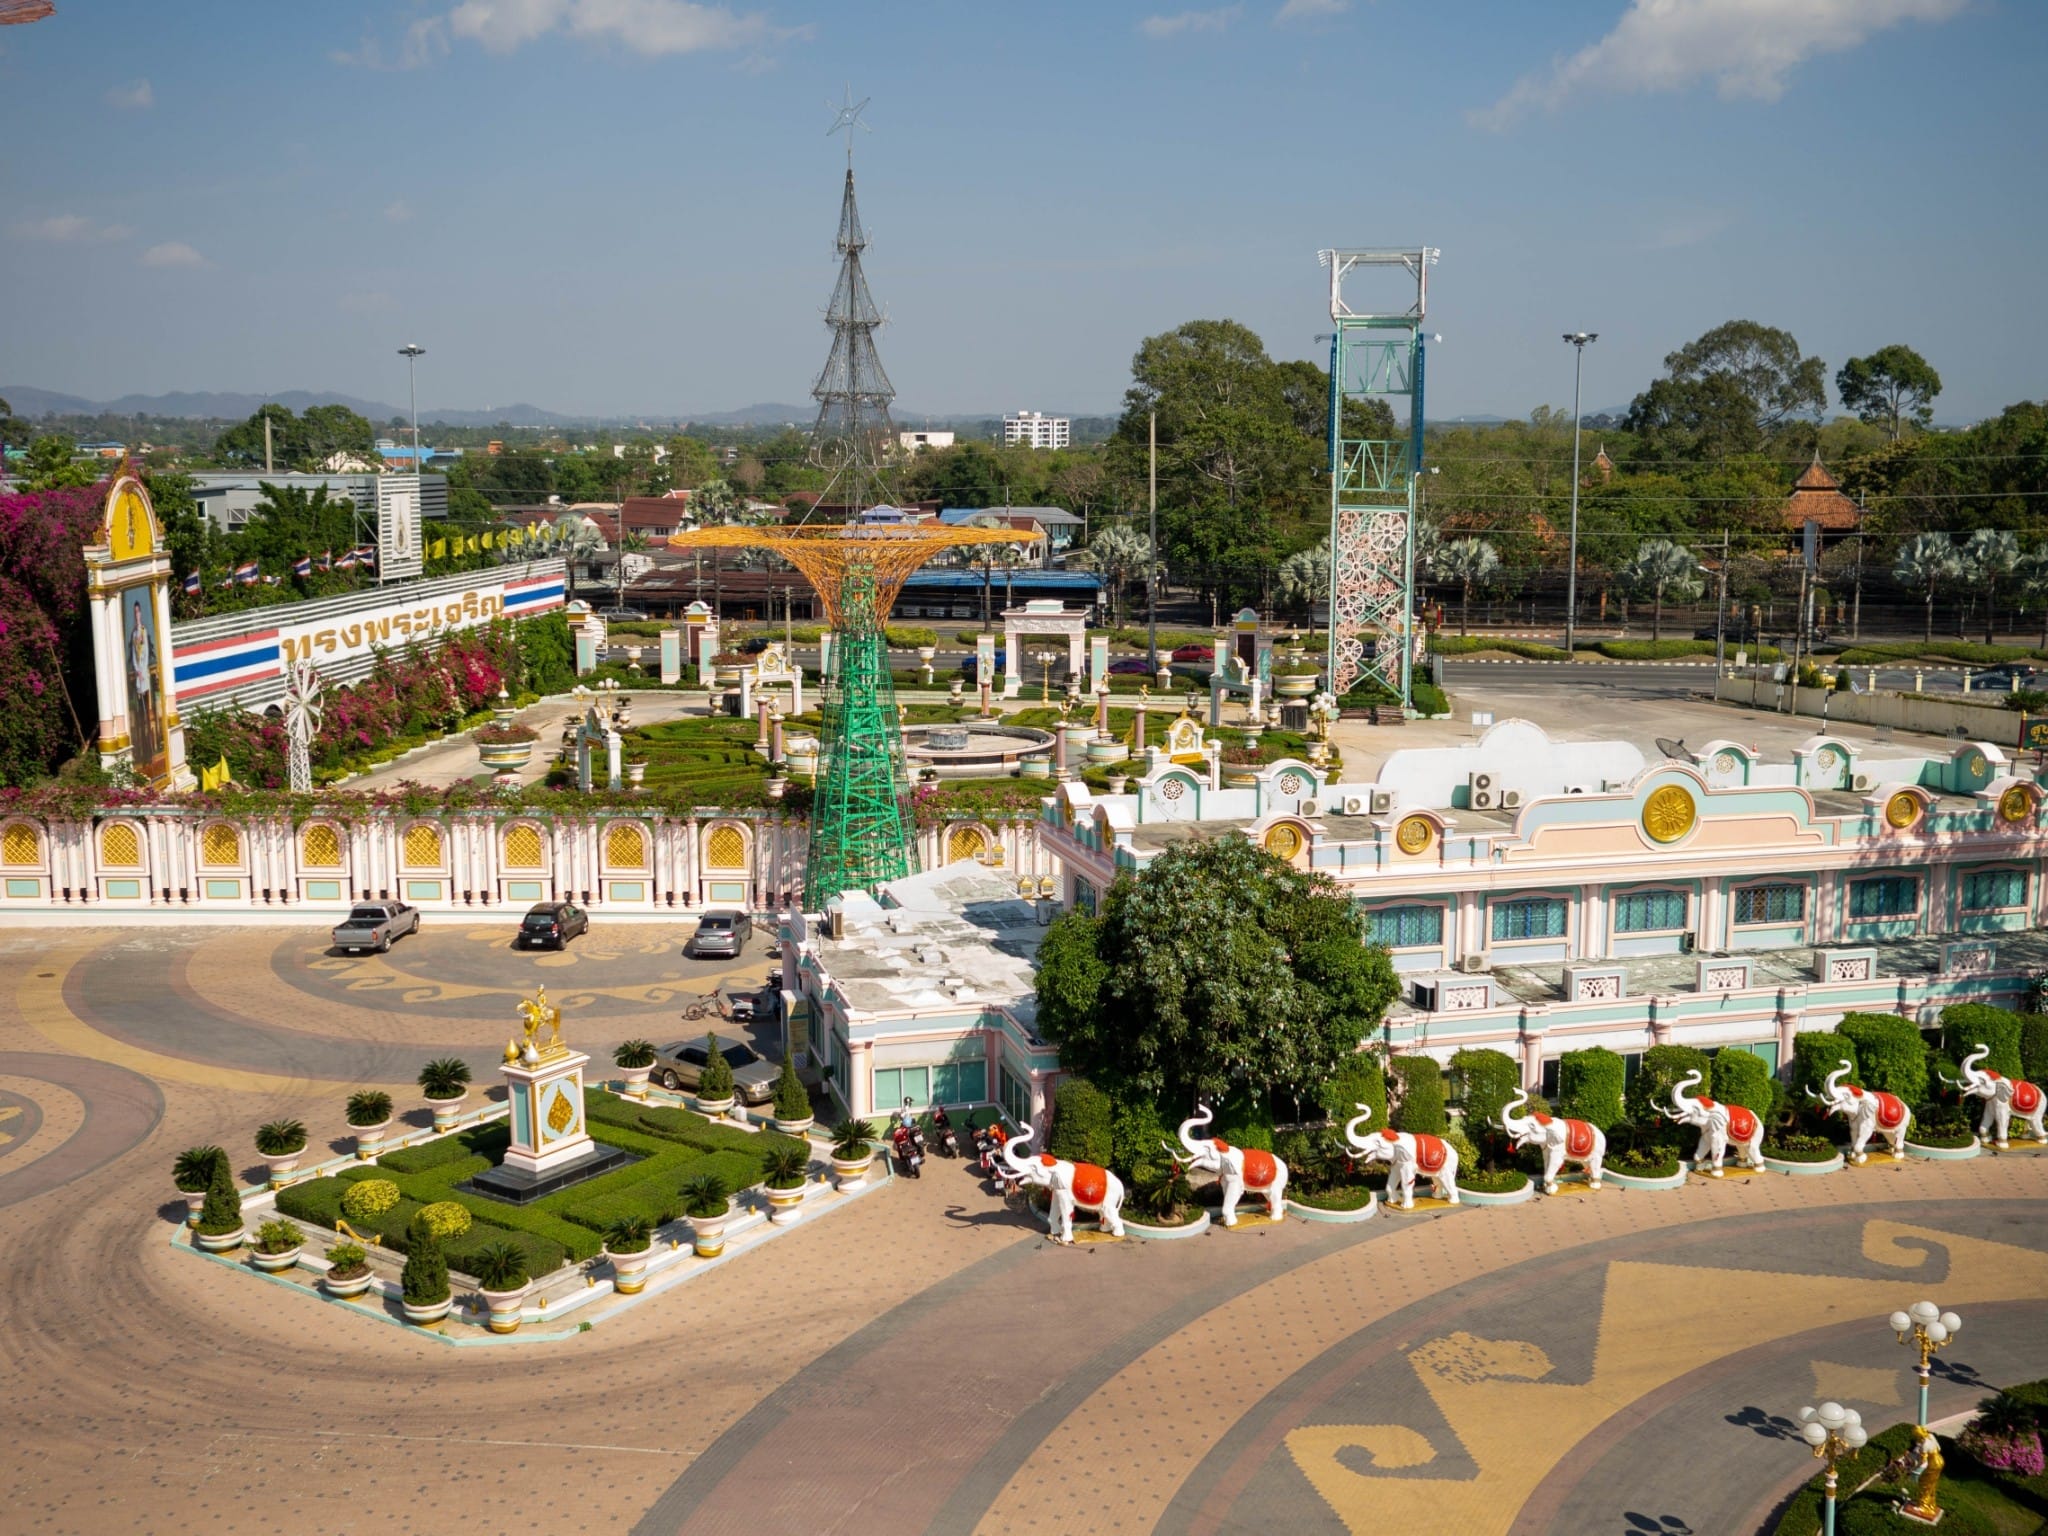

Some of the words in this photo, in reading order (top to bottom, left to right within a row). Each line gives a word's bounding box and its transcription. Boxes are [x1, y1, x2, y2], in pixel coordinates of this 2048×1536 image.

[281, 591, 505, 662] ทรงพระเจริญ
